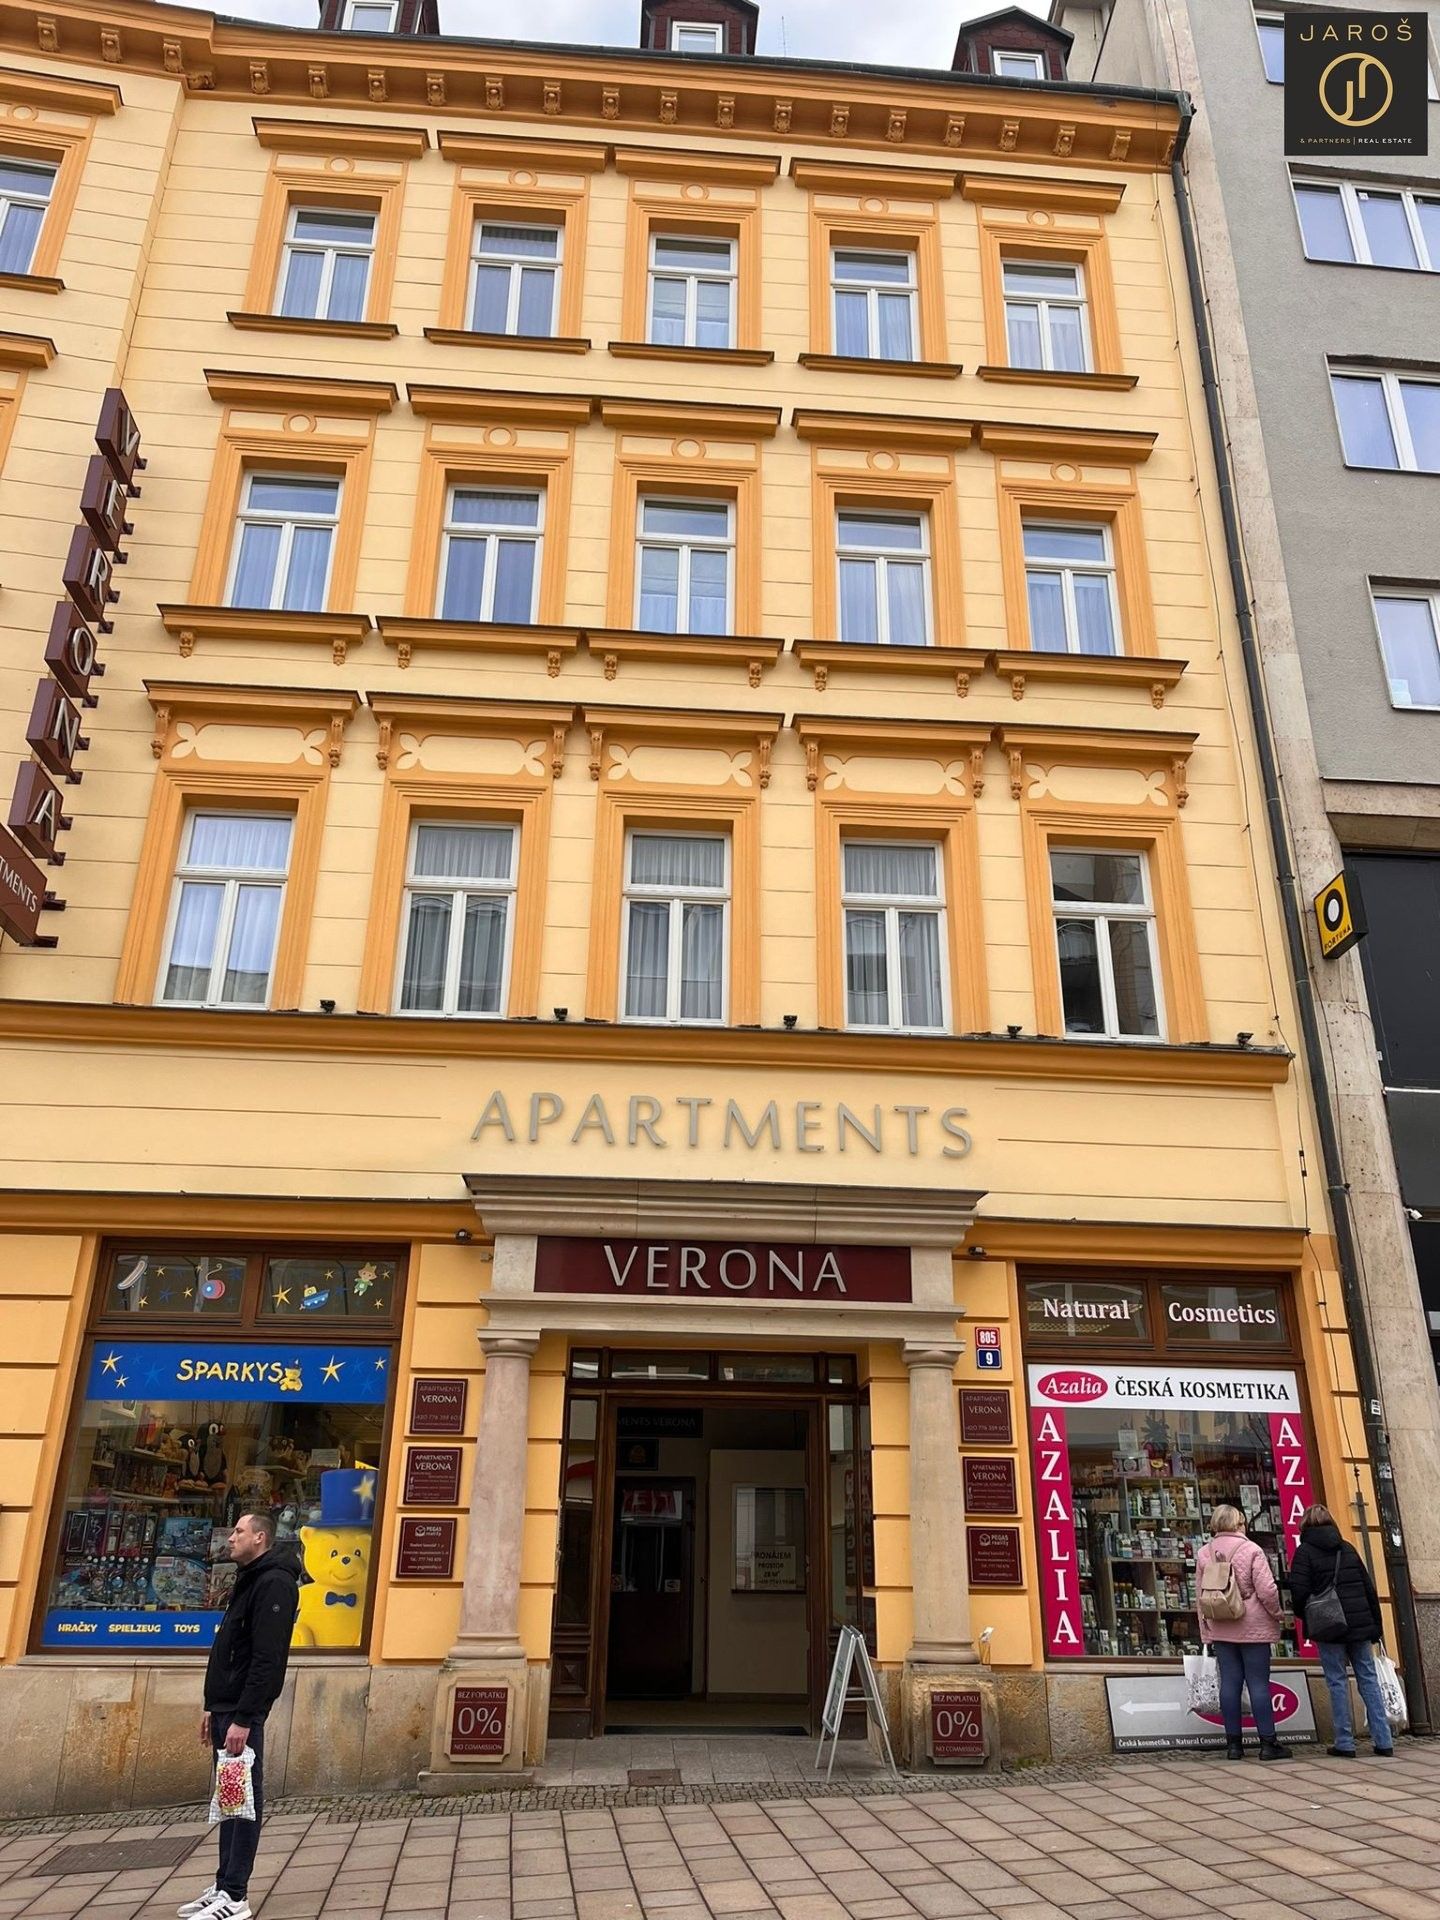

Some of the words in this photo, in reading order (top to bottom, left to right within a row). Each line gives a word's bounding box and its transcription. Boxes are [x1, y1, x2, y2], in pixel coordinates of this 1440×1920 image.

[33, 407, 140, 842] VERONA
[470, 1089, 974, 1158] APARTMENTS
[603, 1243, 848, 1293] VERONA
[1043, 1299, 1131, 1320] Natural
[1168, 1302, 1276, 1324] Cosmetics
[986, 1352, 993, 1365] 9
[176, 1359, 283, 1383] SPARKYS
[1044, 1377, 1104, 1395] Azalia
[1115, 1375, 1174, 1397] ČESKÁ
[1180, 1380, 1290, 1400] KOSMETIKA
[421, 1394, 457, 1403] VERONA
[968, 1405, 1002, 1414] VERONA
[415, 1462, 452, 1470] VERONA
[972, 1472, 1007, 1480] VERONA
[1037, 1412, 1080, 1644] AZALIA
[58, 1621, 98, 1633] HRAČKY
[108, 1623, 161, 1633] SPIELZEUG
[174, 1624, 200, 1633] TOYS
[458, 1707, 502, 1735] 0%
[936, 1710, 979, 1738] 0%
[1176, 1737, 1199, 1745] Natural
